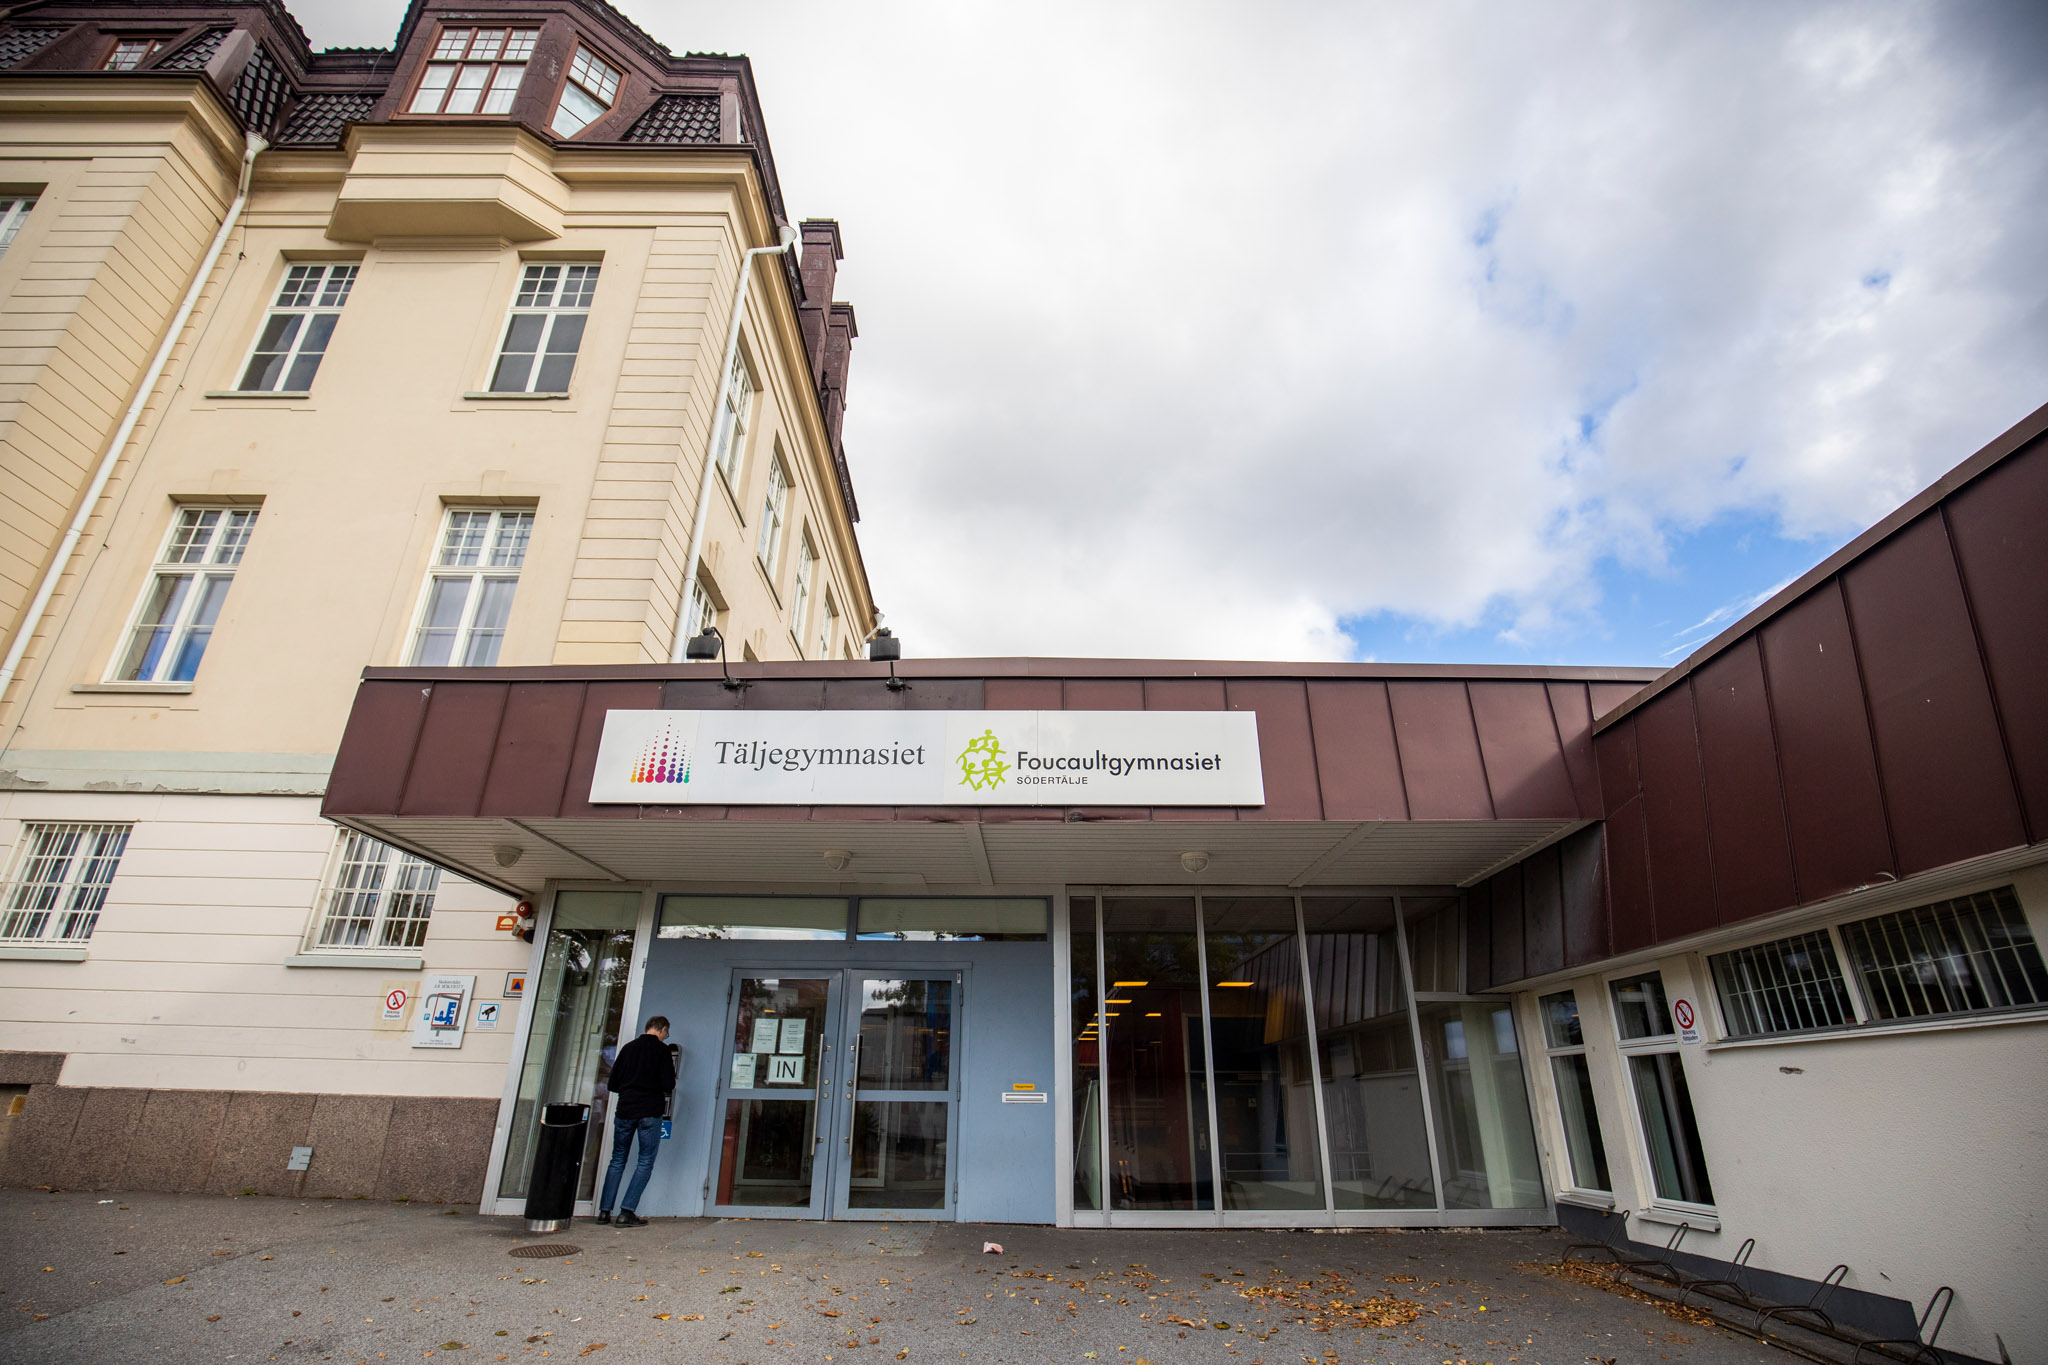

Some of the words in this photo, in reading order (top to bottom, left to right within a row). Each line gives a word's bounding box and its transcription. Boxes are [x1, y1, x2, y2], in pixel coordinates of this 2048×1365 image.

[715, 741, 926, 771] Täljegymnasiet
[1017, 751, 1222, 775] Foucaultgymnasiet
[1017, 775, 1088, 785] SÖDERTÄLJE
[776, 1061, 796, 1078] IN
